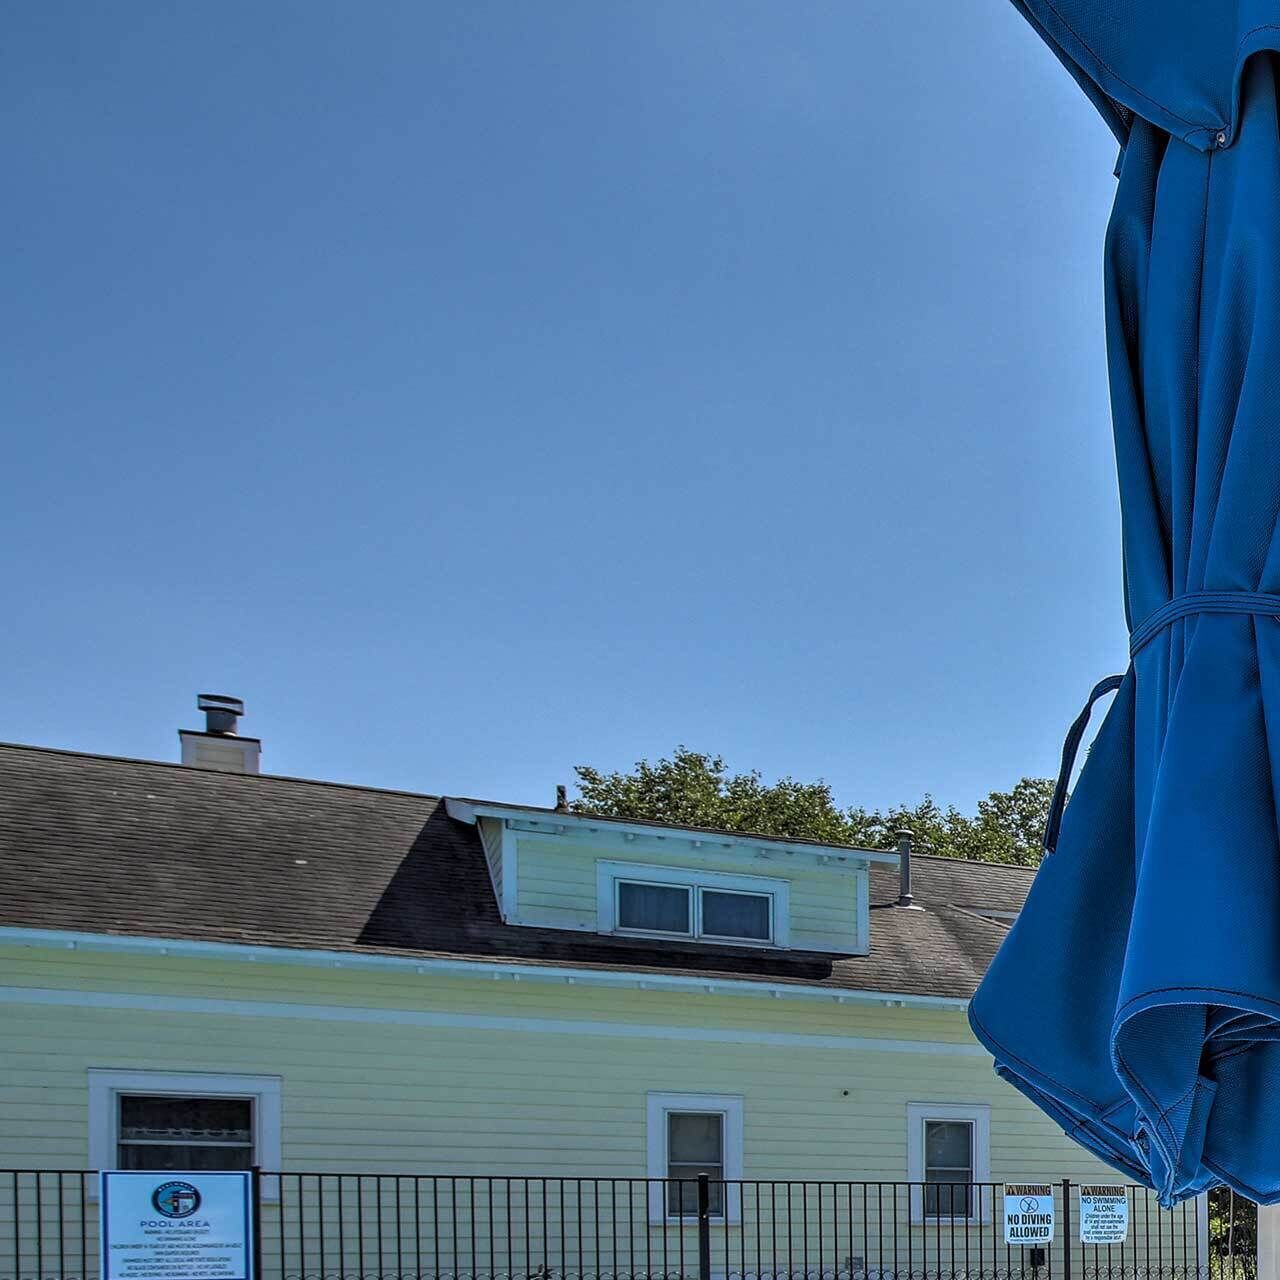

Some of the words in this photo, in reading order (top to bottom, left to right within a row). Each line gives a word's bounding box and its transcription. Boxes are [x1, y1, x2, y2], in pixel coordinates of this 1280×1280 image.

[1018, 1185, 1051, 1196] WARNING
[1090, 1186, 1125, 1196] WARNING
[140, 1220, 174, 1228] POOL
[179, 1220, 210, 1228] AREA
[1007, 1214, 1020, 1225] NO
[1021, 1214, 1052, 1225] DIVING
[1010, 1227, 1050, 1238] ALLOWED
